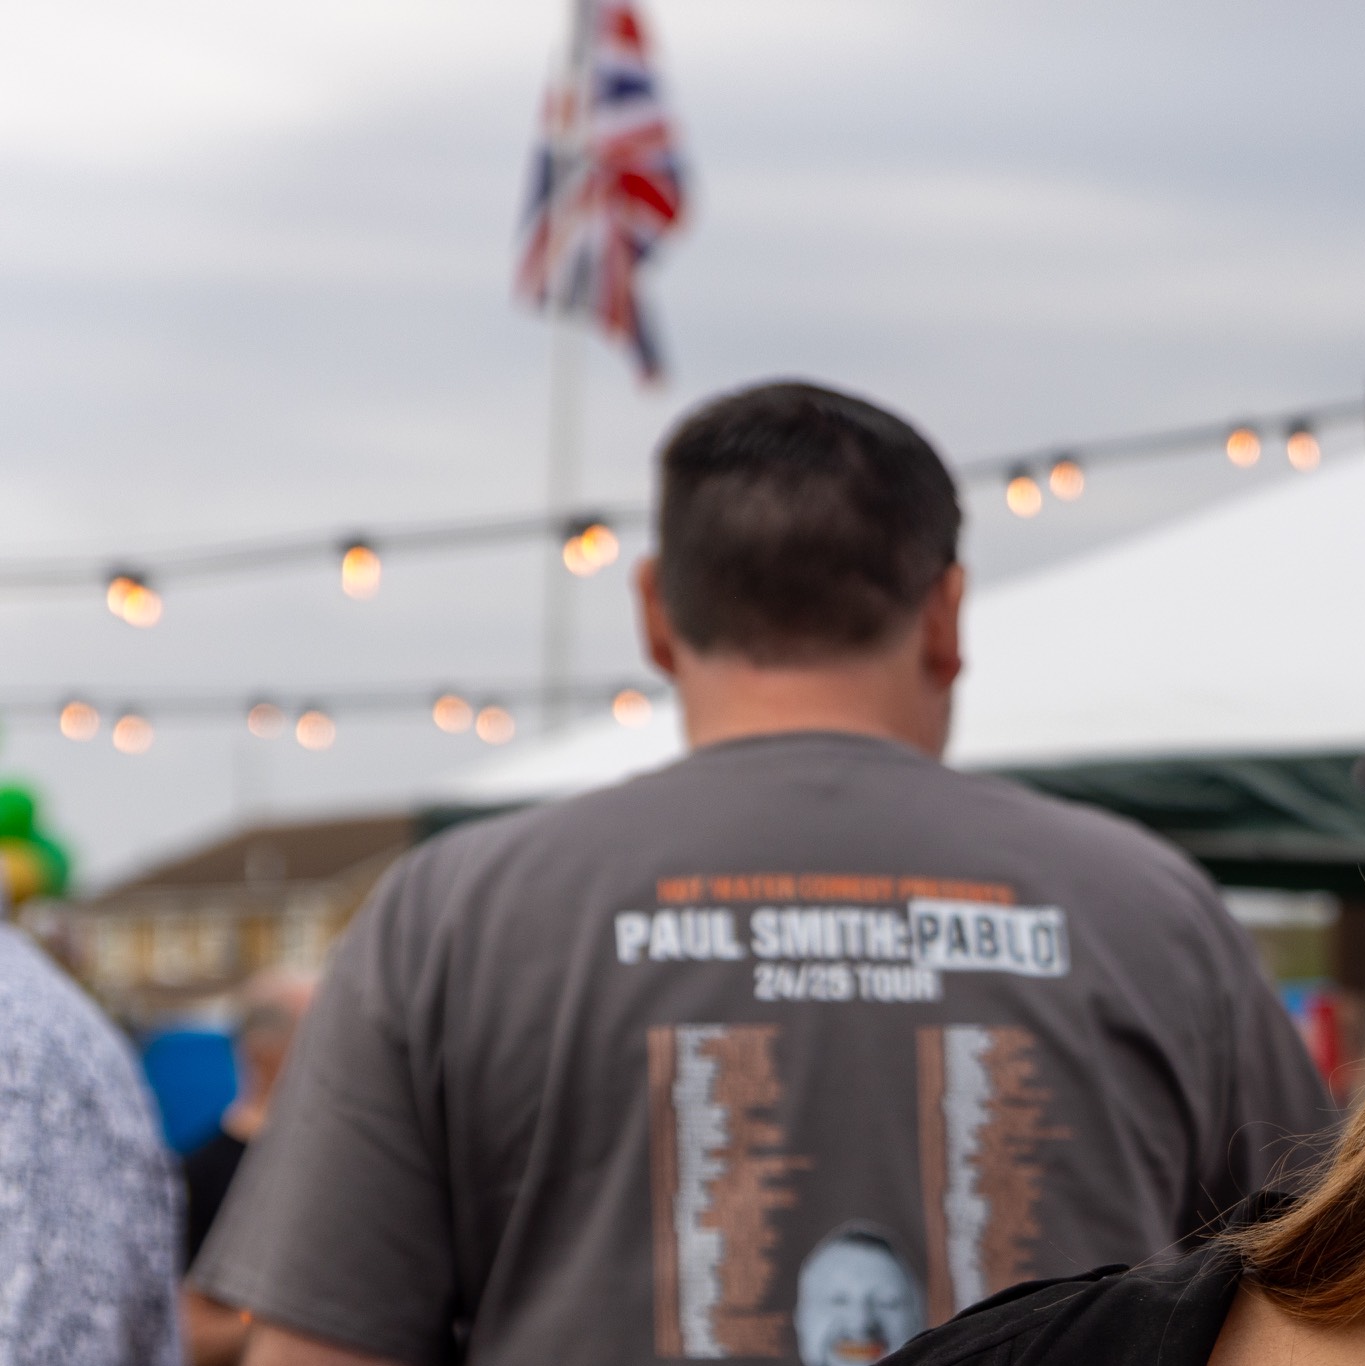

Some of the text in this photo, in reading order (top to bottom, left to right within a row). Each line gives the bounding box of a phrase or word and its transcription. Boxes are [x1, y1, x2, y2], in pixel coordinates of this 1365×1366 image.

[615, 909, 745, 964] PAUL
[917, 912, 1060, 970] PABLO
[754, 963, 942, 1002] 24/25 TOUR
